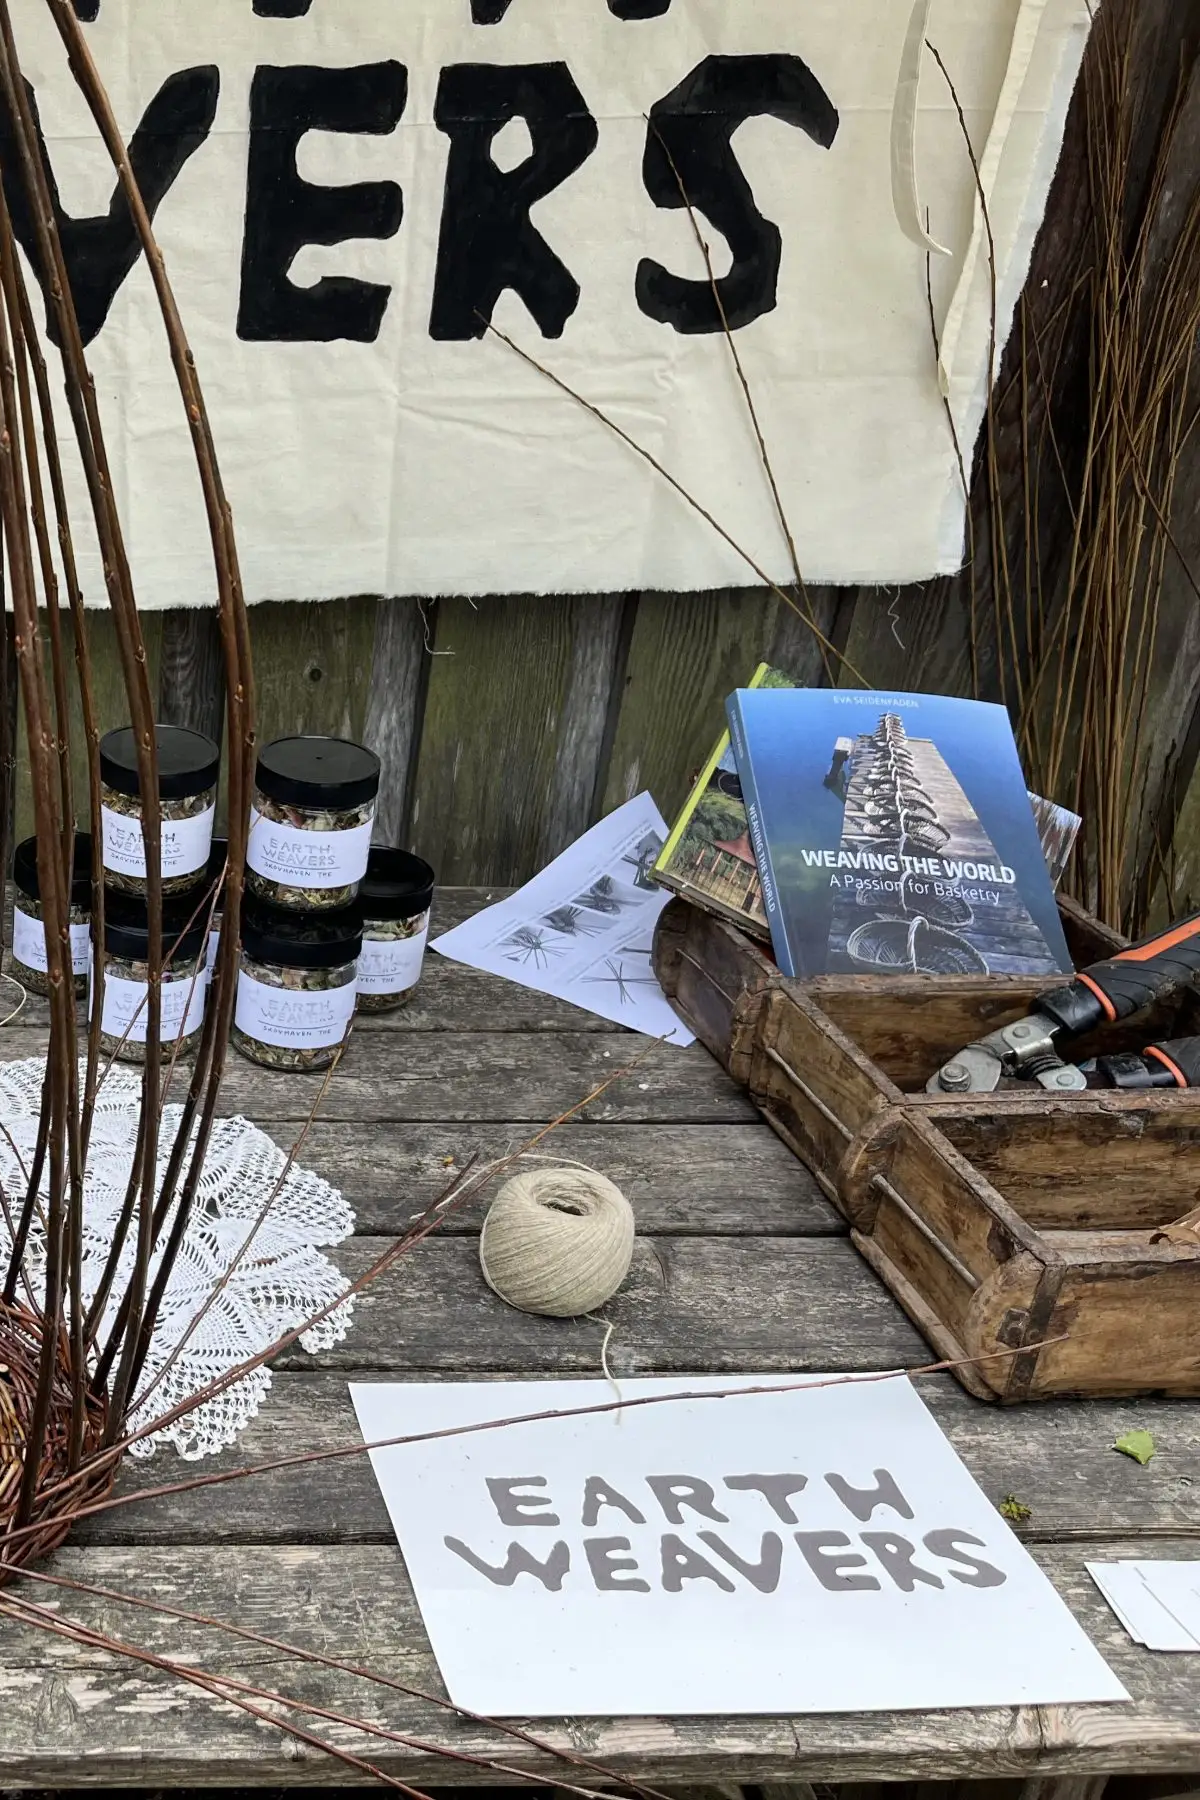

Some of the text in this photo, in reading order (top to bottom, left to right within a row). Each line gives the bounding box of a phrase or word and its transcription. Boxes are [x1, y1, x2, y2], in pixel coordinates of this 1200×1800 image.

[833, 695, 852, 705] EVA
[109, 835, 182, 855] WEARS
[117, 828, 176, 843] EAH
[269, 837, 331, 854] EARTH
[262, 844, 337, 867] WEAVERS
[748, 802, 776, 913] WEAVING THE WORLD
[801, 849, 1016, 885] WEAVING THE WORLD
[829, 873, 1001, 906] A Passion for Basketry
[268, 999, 330, 1012] EARTH
[484, 1469, 916, 1527] EARTH
[443, 1529, 1008, 1594] WEAVERS
